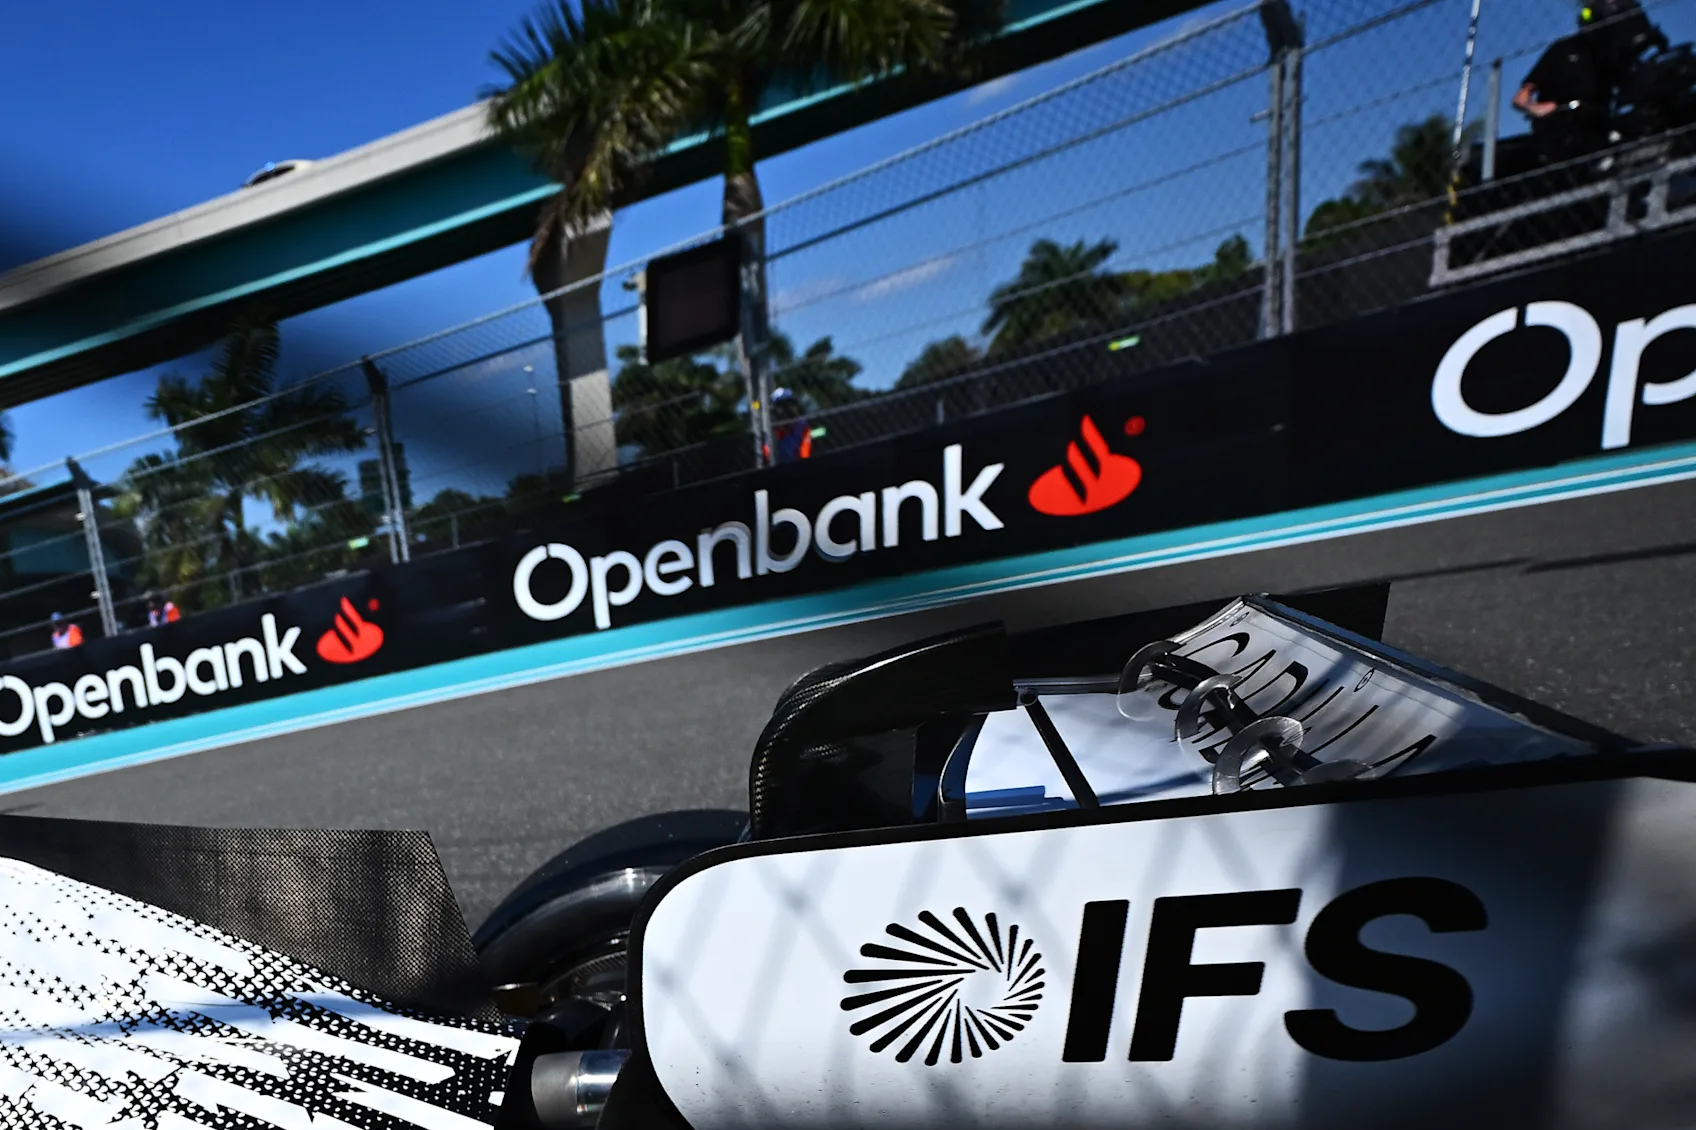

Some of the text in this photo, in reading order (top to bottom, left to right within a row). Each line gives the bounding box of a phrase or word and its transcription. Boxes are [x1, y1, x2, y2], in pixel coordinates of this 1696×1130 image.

[1432, 301, 1696, 450] Op
[513, 443, 1004, 630] Openbank
[1062, 876, 1489, 1062] IFS
